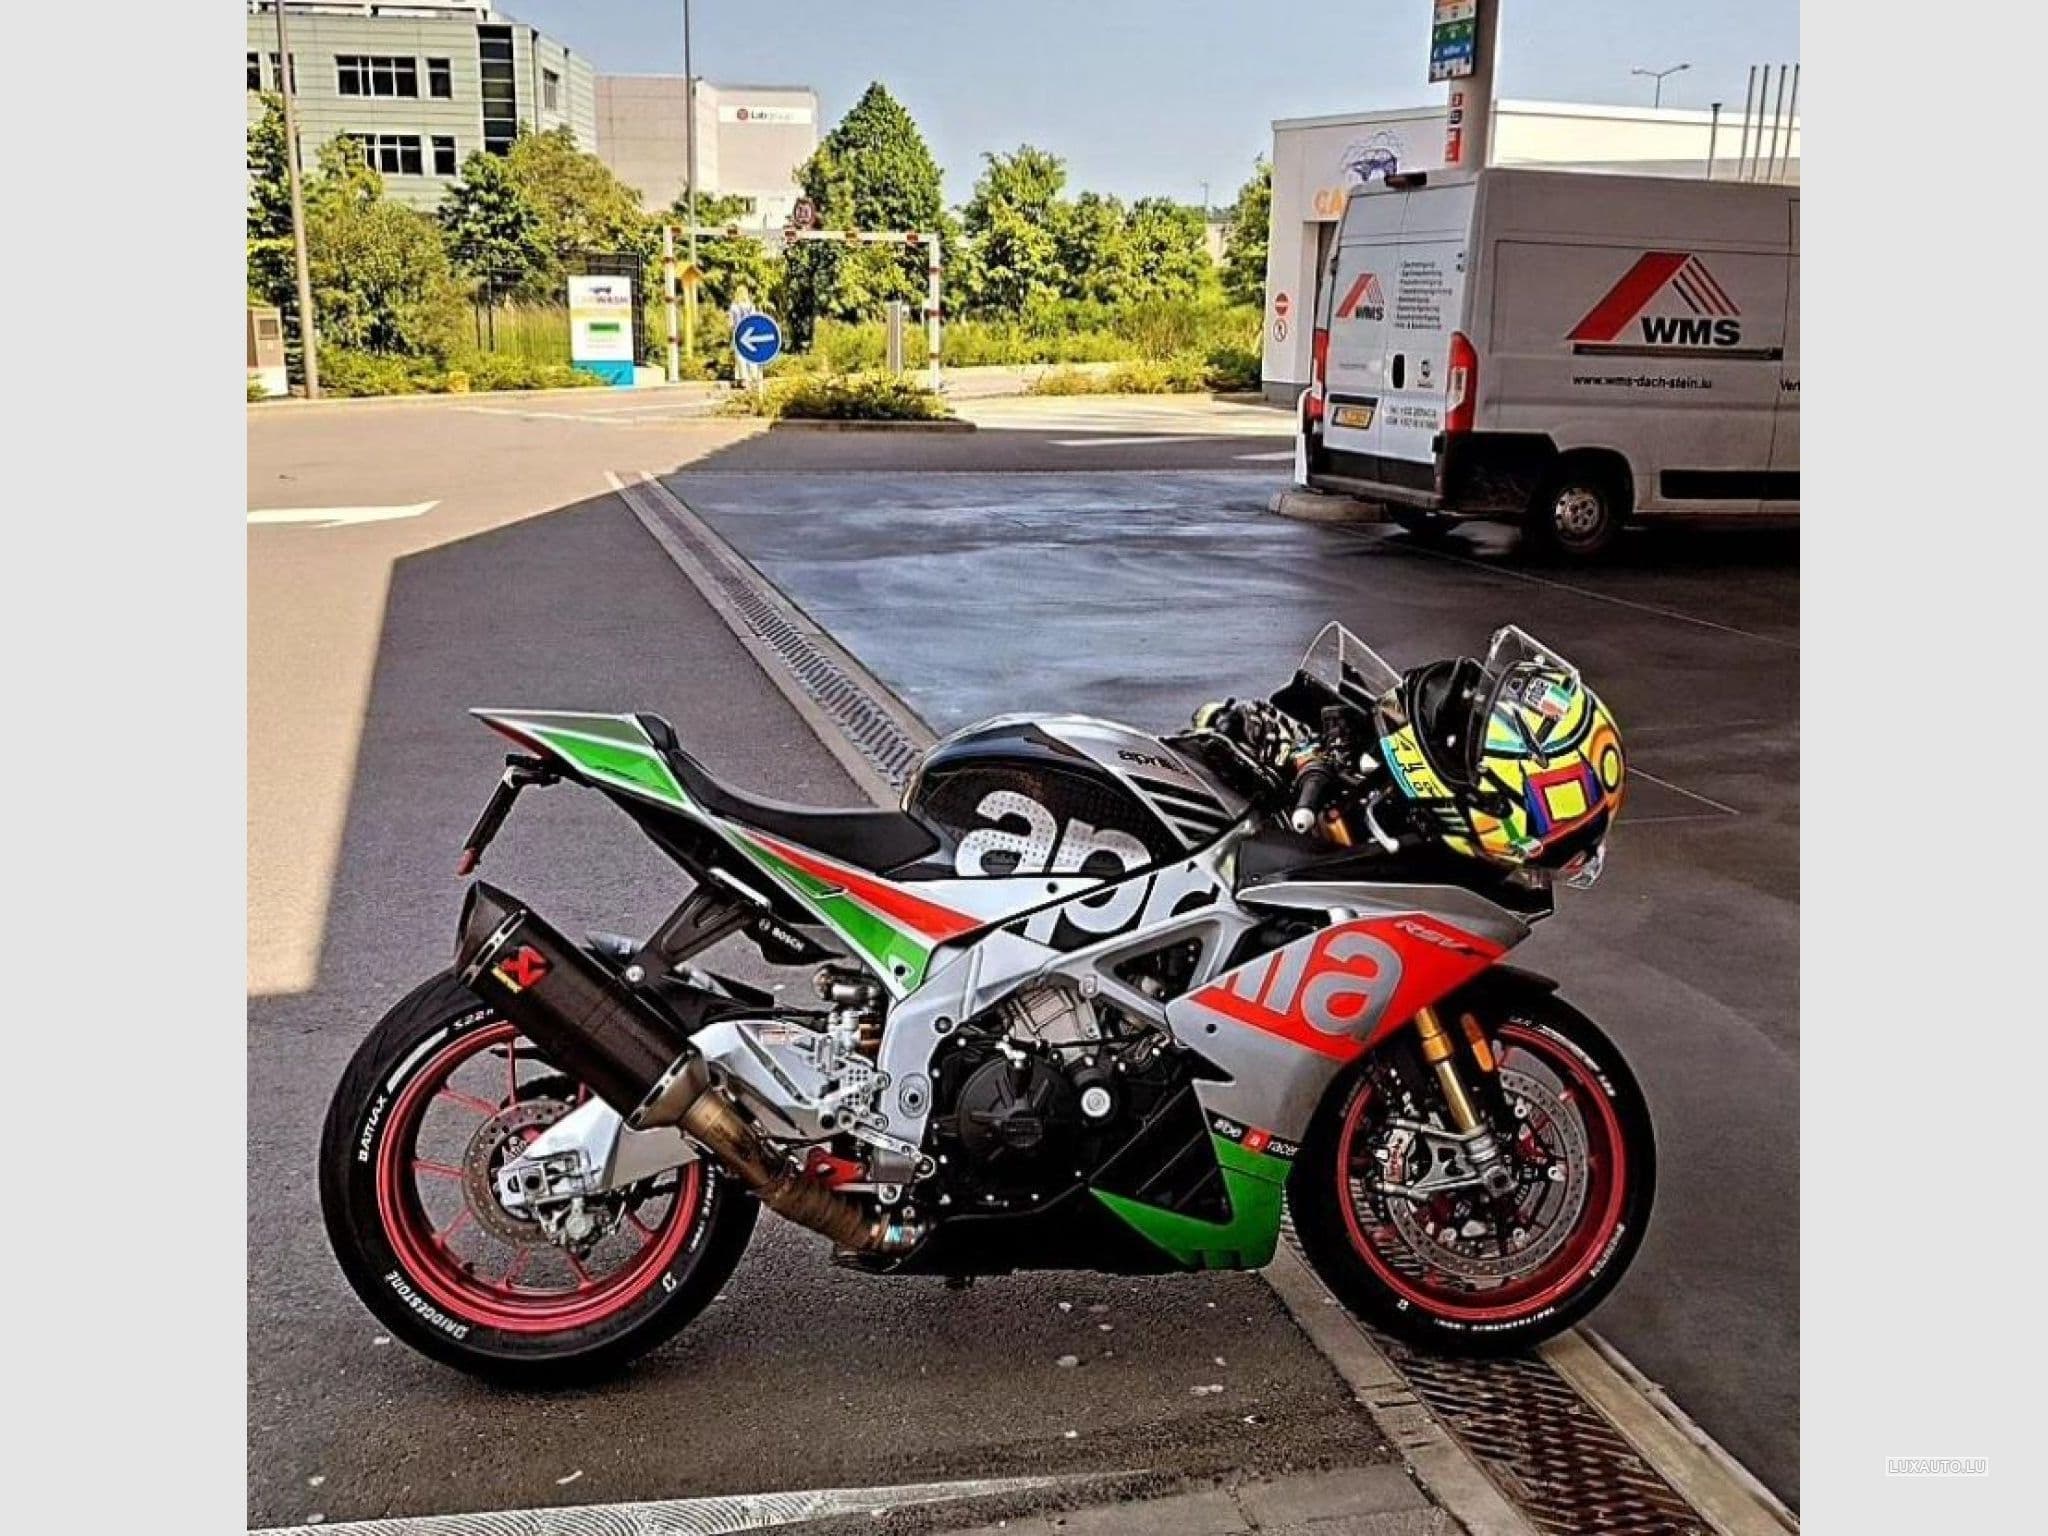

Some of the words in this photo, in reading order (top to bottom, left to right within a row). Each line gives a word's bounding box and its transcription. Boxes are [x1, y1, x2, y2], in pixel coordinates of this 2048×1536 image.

[1356, 305, 1385, 321] WMS
[1641, 316, 1741, 346] WMS
[1572, 375, 1712, 390] www.wms-dach-stein.lu
[772, 927, 805, 952] BOSCH
